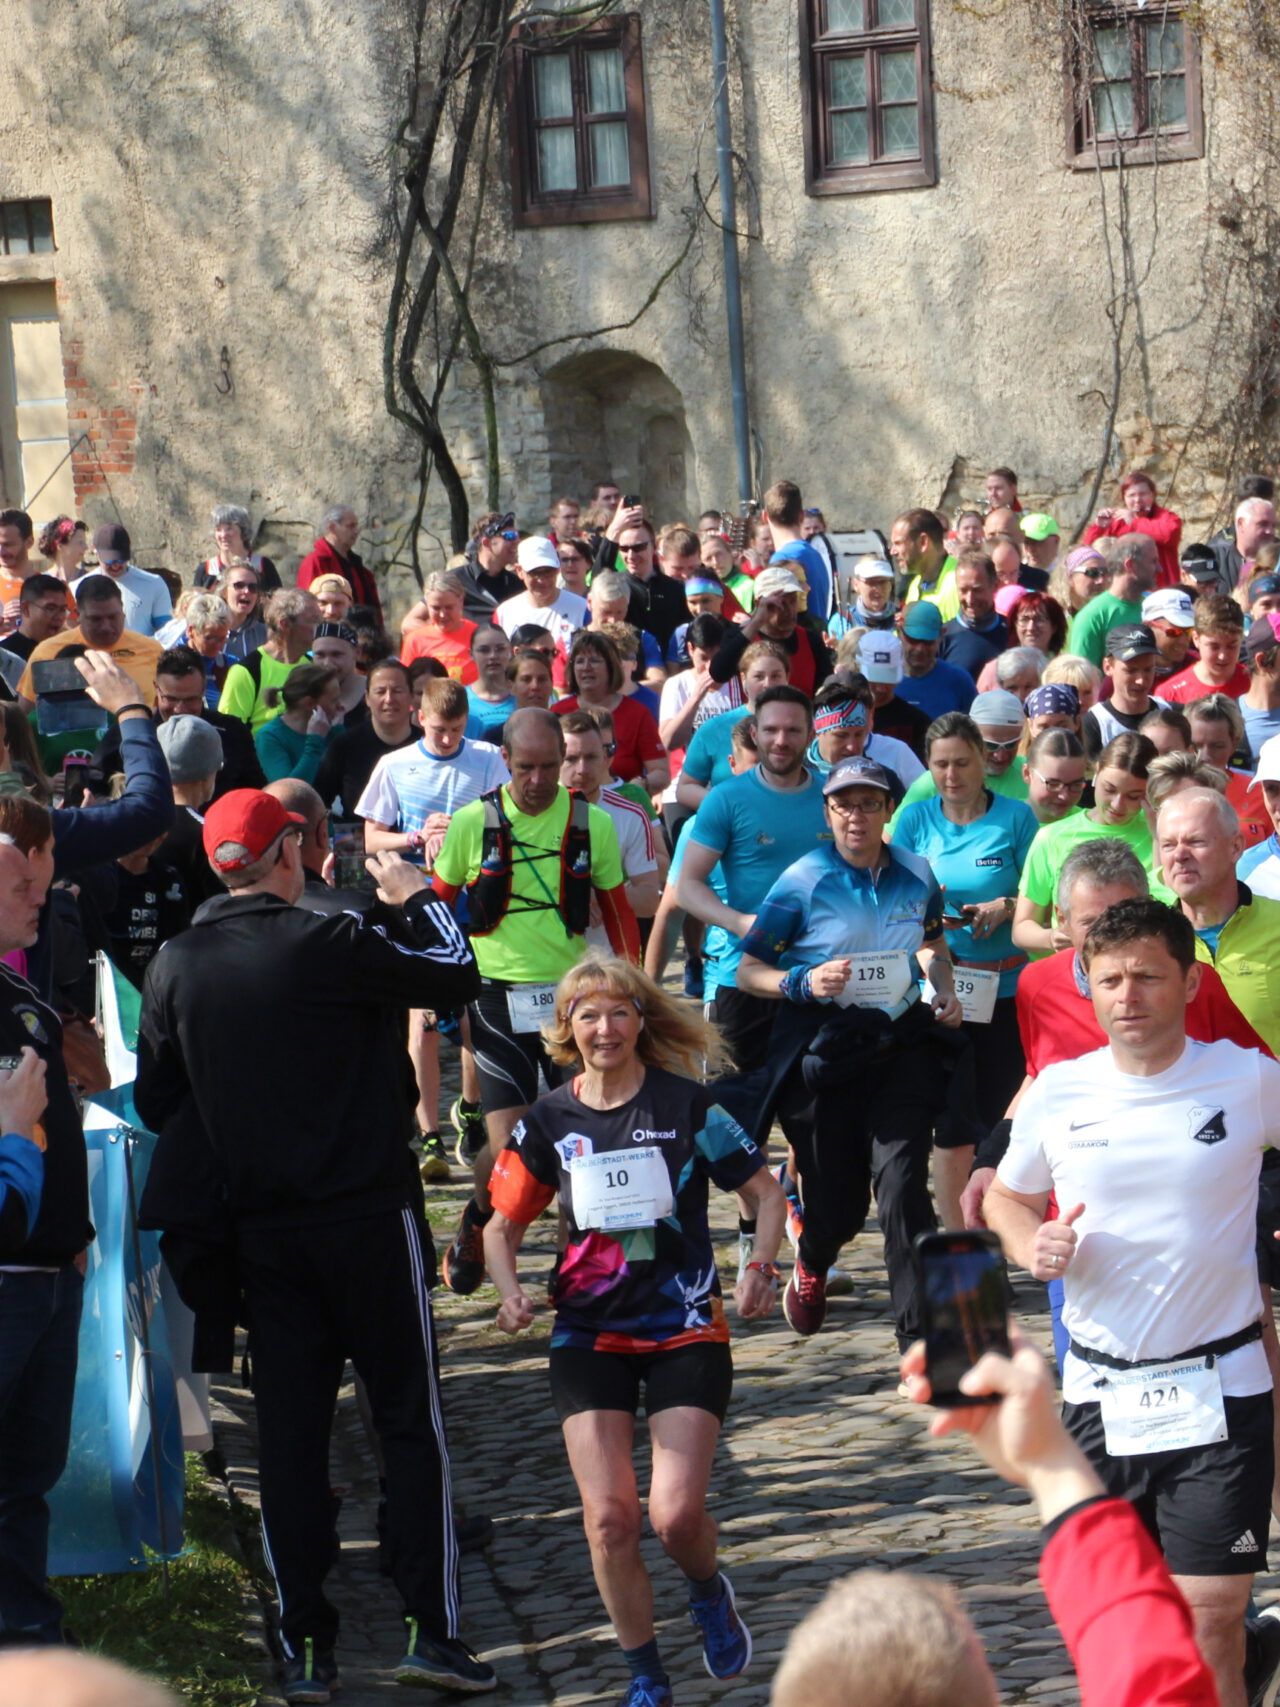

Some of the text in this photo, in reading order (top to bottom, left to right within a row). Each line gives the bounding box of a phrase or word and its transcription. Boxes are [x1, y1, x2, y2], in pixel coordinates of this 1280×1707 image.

[858, 966, 886, 981] 178
[530, 992, 554, 1006] 180
[645, 1129, 676, 1139] hexad
[605, 1169, 629, 1189] 10
[1139, 1386, 1180, 1409] 424
